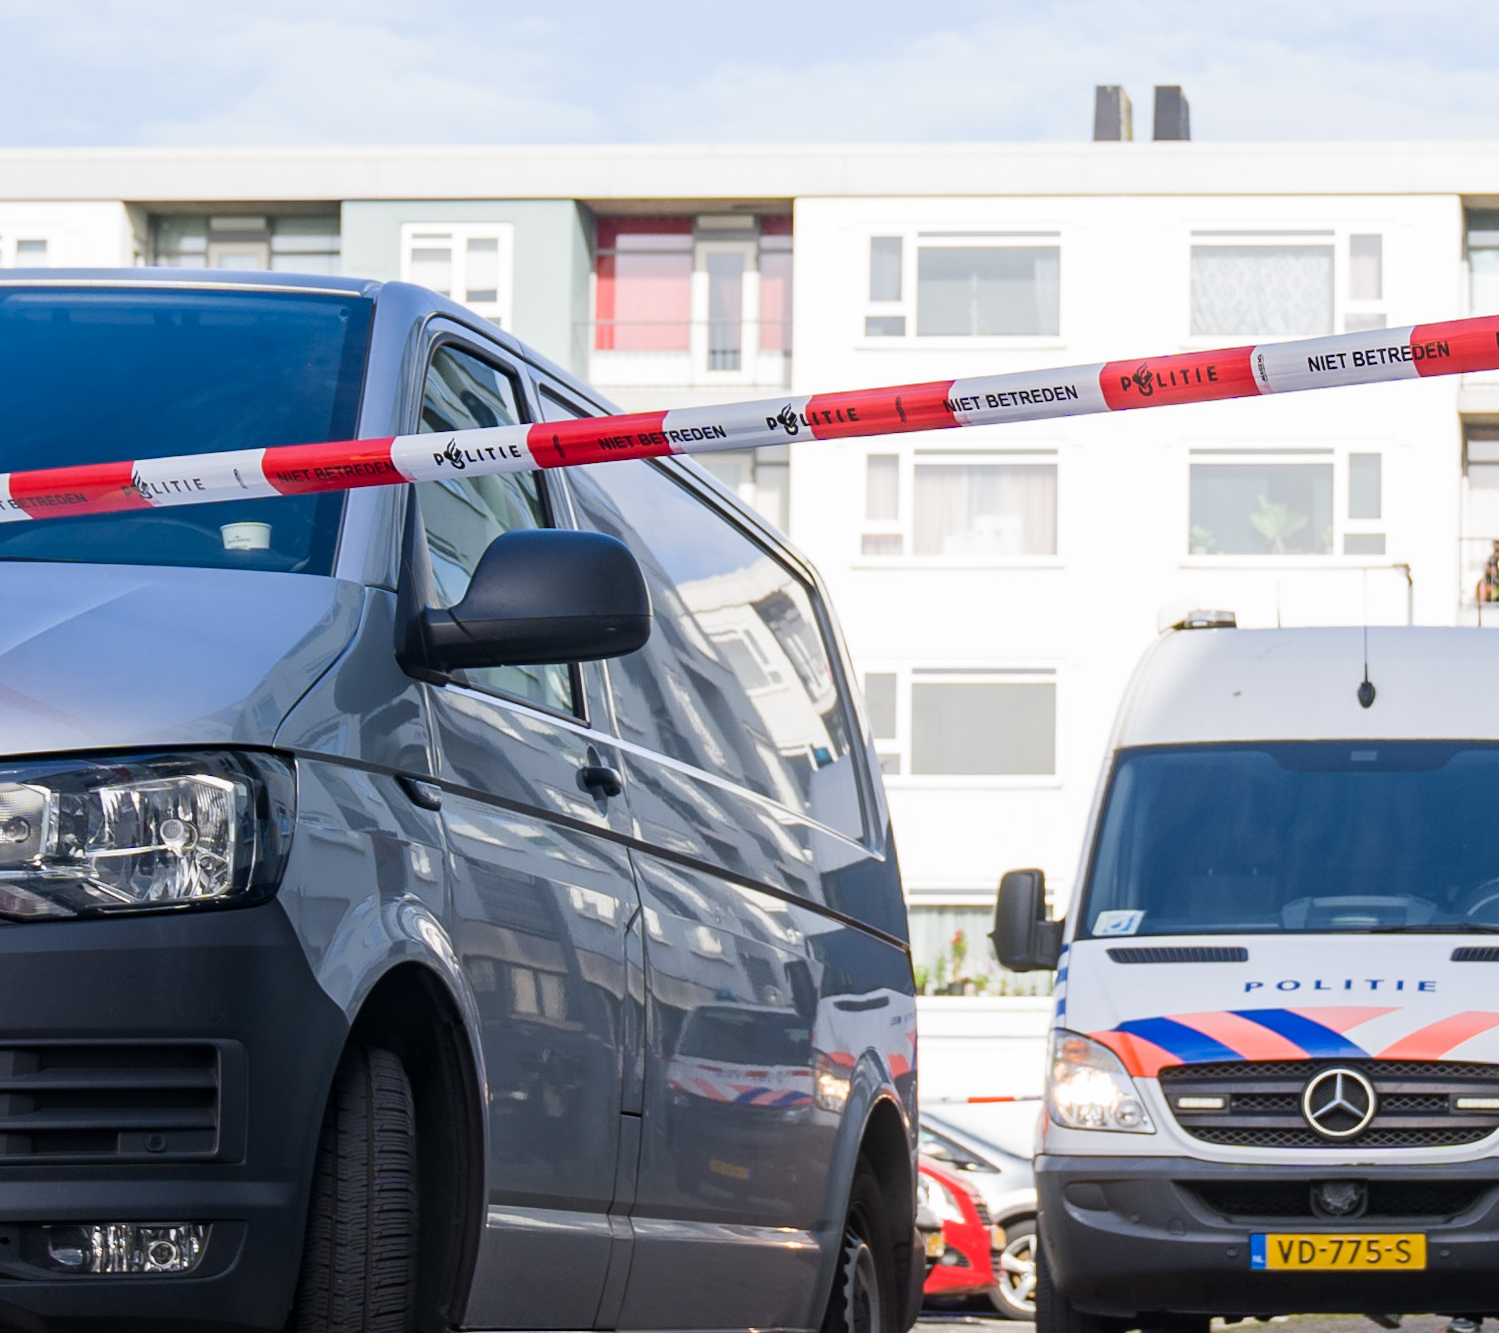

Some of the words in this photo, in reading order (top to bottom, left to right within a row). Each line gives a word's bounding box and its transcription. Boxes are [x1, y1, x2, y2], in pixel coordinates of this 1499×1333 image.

[1307, 351, 1348, 373] NIET
[1353, 340, 1450, 367] BETREDEN
[1120, 363, 1219, 398] POLITIE
[942, 396, 981, 415] NIET
[984, 385, 1079, 410] BETREDEN
[765, 402, 860, 436] POLITIE
[597, 434, 634, 452] NIET
[636, 424, 727, 448] BETREDEN
[432, 437, 522, 470] POLITIE
[120, 470, 206, 499] POLITIE
[276, 467, 313, 484] NIET
[313, 460, 397, 481] BETREDEN
[6, 492, 87, 511] BETREDEN
[1243, 979, 1438, 993] POLITIE
[1277, 1239, 1411, 1265] VD-775-S
